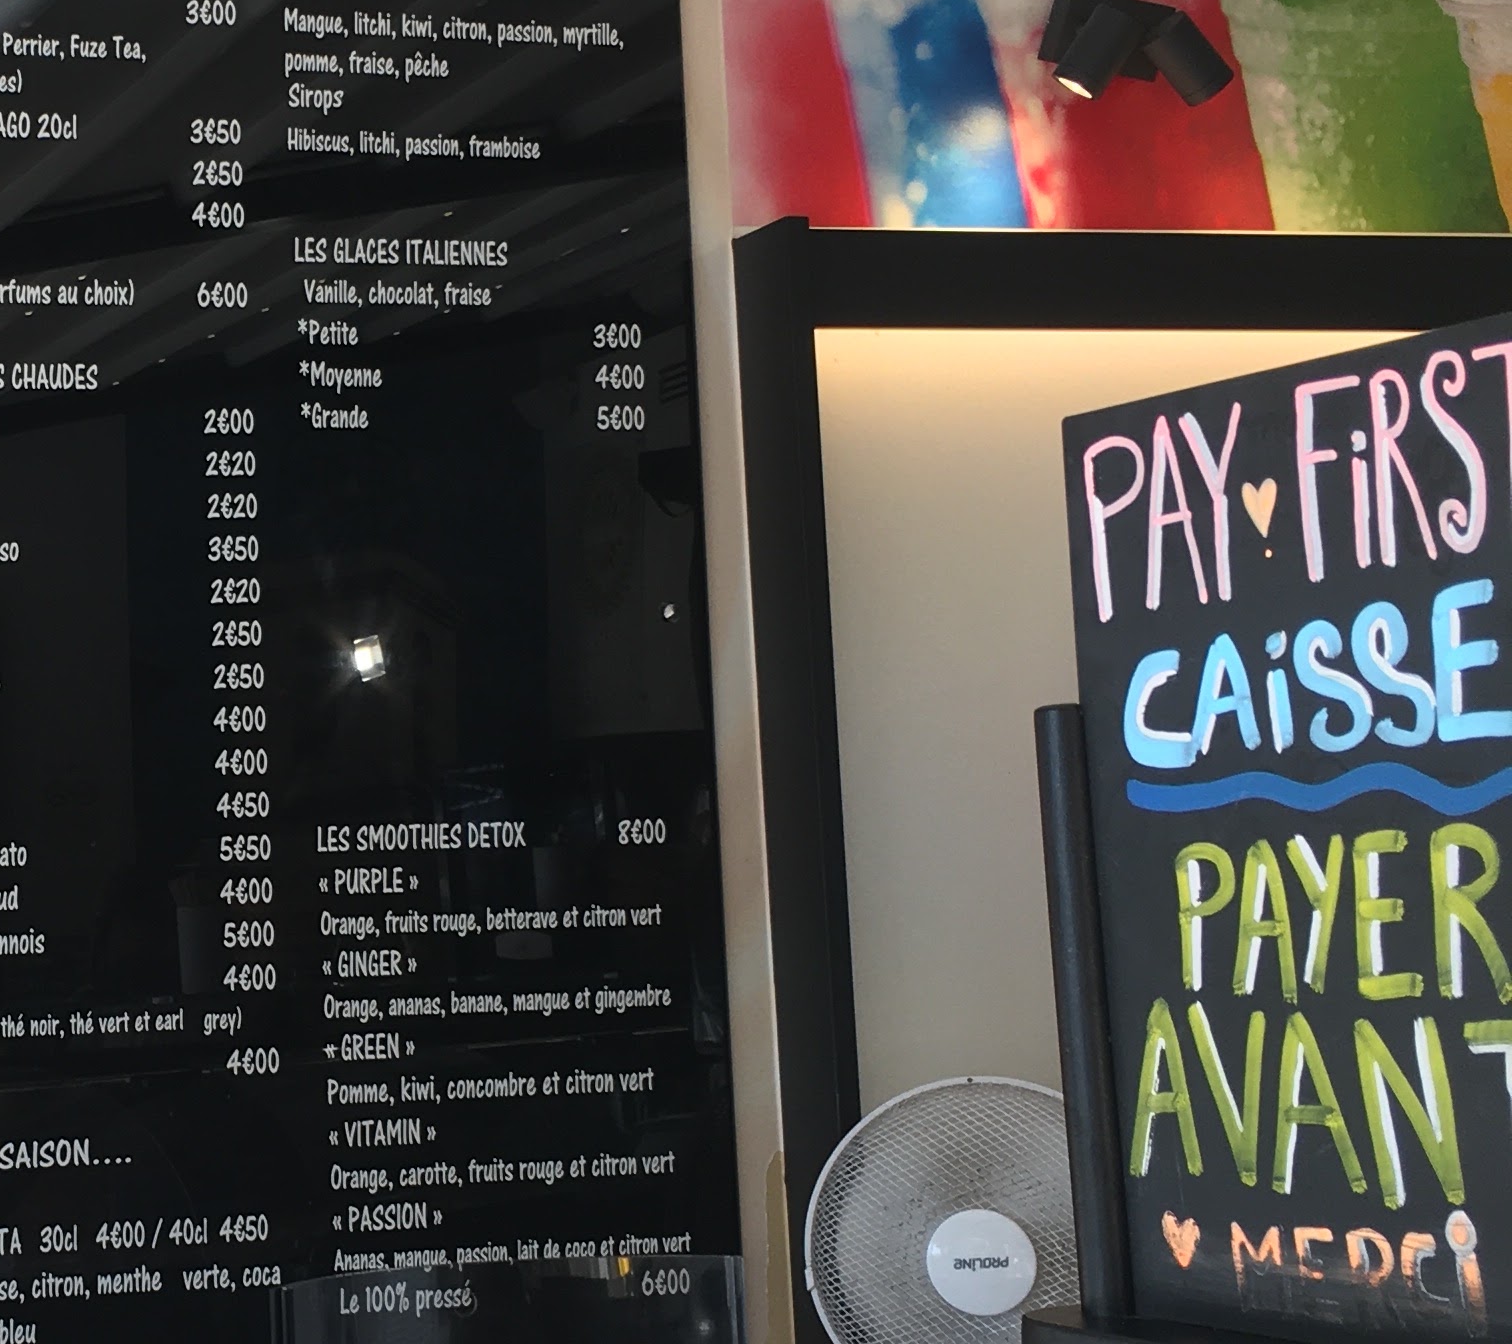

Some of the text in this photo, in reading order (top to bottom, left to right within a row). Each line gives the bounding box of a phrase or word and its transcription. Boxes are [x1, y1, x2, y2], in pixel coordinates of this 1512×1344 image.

[284, 6, 624, 52] Mangue, litchi, kiwi, citron, passion, myrtille,
[288, 82, 344, 116] Sirops
[36, 112, 78, 140] 20cl
[190, 117, 242, 145] 3€50
[191, 201, 245, 228] 4€00
[294, 236, 508, 267] LES GLACES ITALIENNES
[303, 278, 492, 310] Vanille, chocolat, fraise
[11, 362, 98, 390] CHAUDES
[203, 407, 254, 435] 2€00
[1084, 402, 1241, 623] PAY
[207, 534, 259, 562] 3€50
[216, 790, 270, 819] 4€50
[219, 834, 272, 862] 5€50
[316, 818, 666, 853] LES SMOOTHIES DETOX 8€00
[320, 903, 662, 941] Orange, fruits rouge, betterave et citron vert
[1175, 823, 1512, 1005] PAYER
[223, 920, 275, 948] 5€00
[226, 1046, 280, 1076] 4€00
[340, 1267, 690, 1318] Le 100% pressé 6€00
